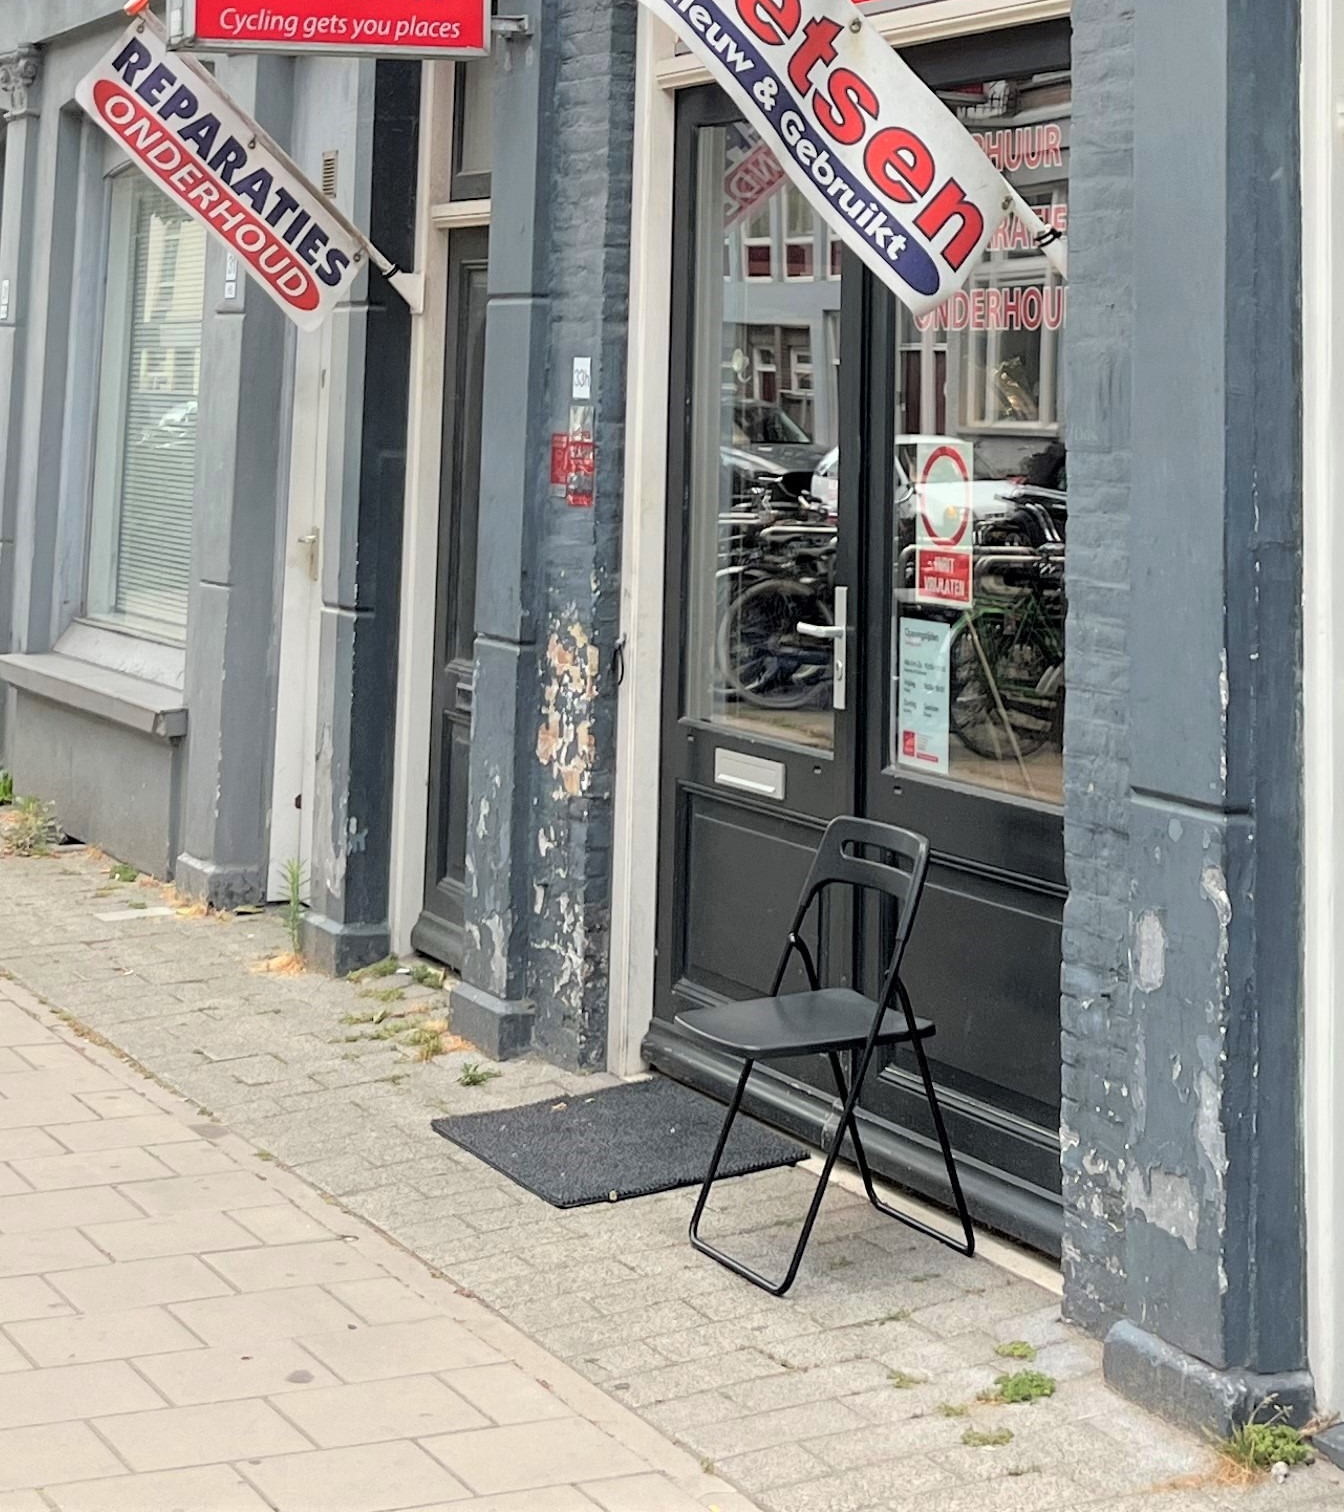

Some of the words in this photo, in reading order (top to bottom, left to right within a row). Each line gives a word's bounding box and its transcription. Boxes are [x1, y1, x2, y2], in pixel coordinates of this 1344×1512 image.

[219, 7, 297, 39] Cycling
[303, 14, 347, 38] gets
[351, 19, 392, 41] you
[394, 15, 461, 39] places
[103, 94, 309, 299] ONDERHOUD
[111, 37, 351, 288] REPARATIES
[752, 76, 781, 112] &
[779, 110, 908, 262] Gebruikt
